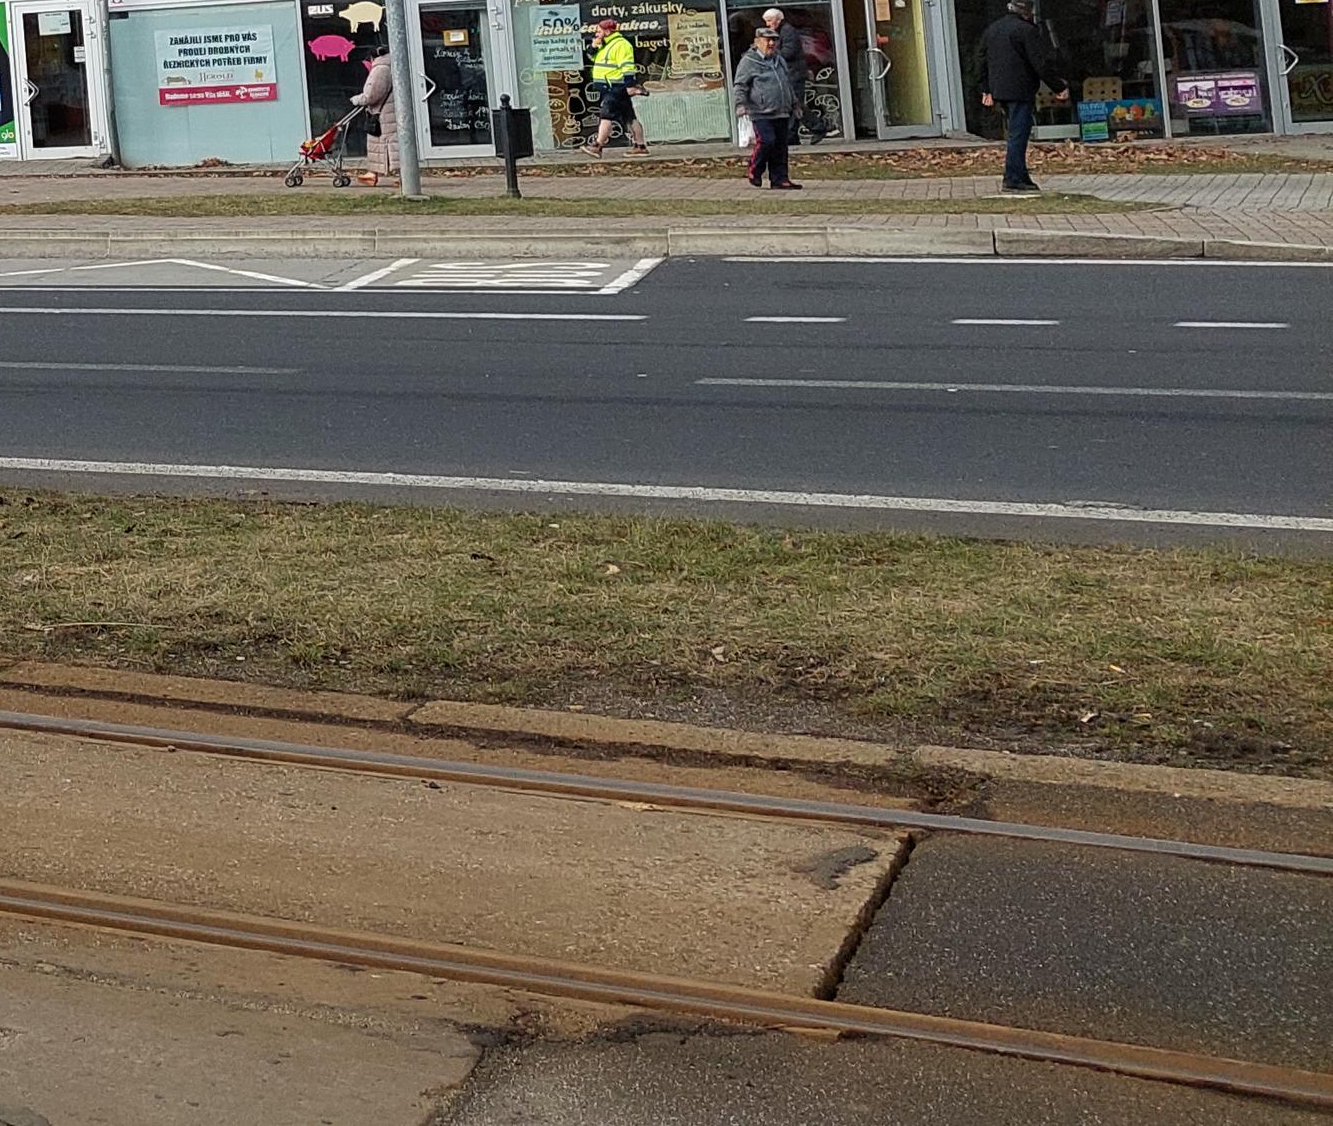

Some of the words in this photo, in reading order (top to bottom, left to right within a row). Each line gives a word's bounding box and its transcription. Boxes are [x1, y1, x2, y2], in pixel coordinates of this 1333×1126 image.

[591, 5, 629, 19] dorty,
[631, 1, 687, 16] zákusky,
[203, 35, 223, 44] JSME
[224, 34, 241, 43] PRO
[241, 30, 258, 42] VÁS
[178, 47, 207, 57] PRODEJ
[208, 45, 251, 55] DROBNÝCH
[163, 57, 211, 69] ŘEZNICKÝCH
[212, 56, 242, 67] POTŘEB
[243, 56, 268, 65] FIRMY
